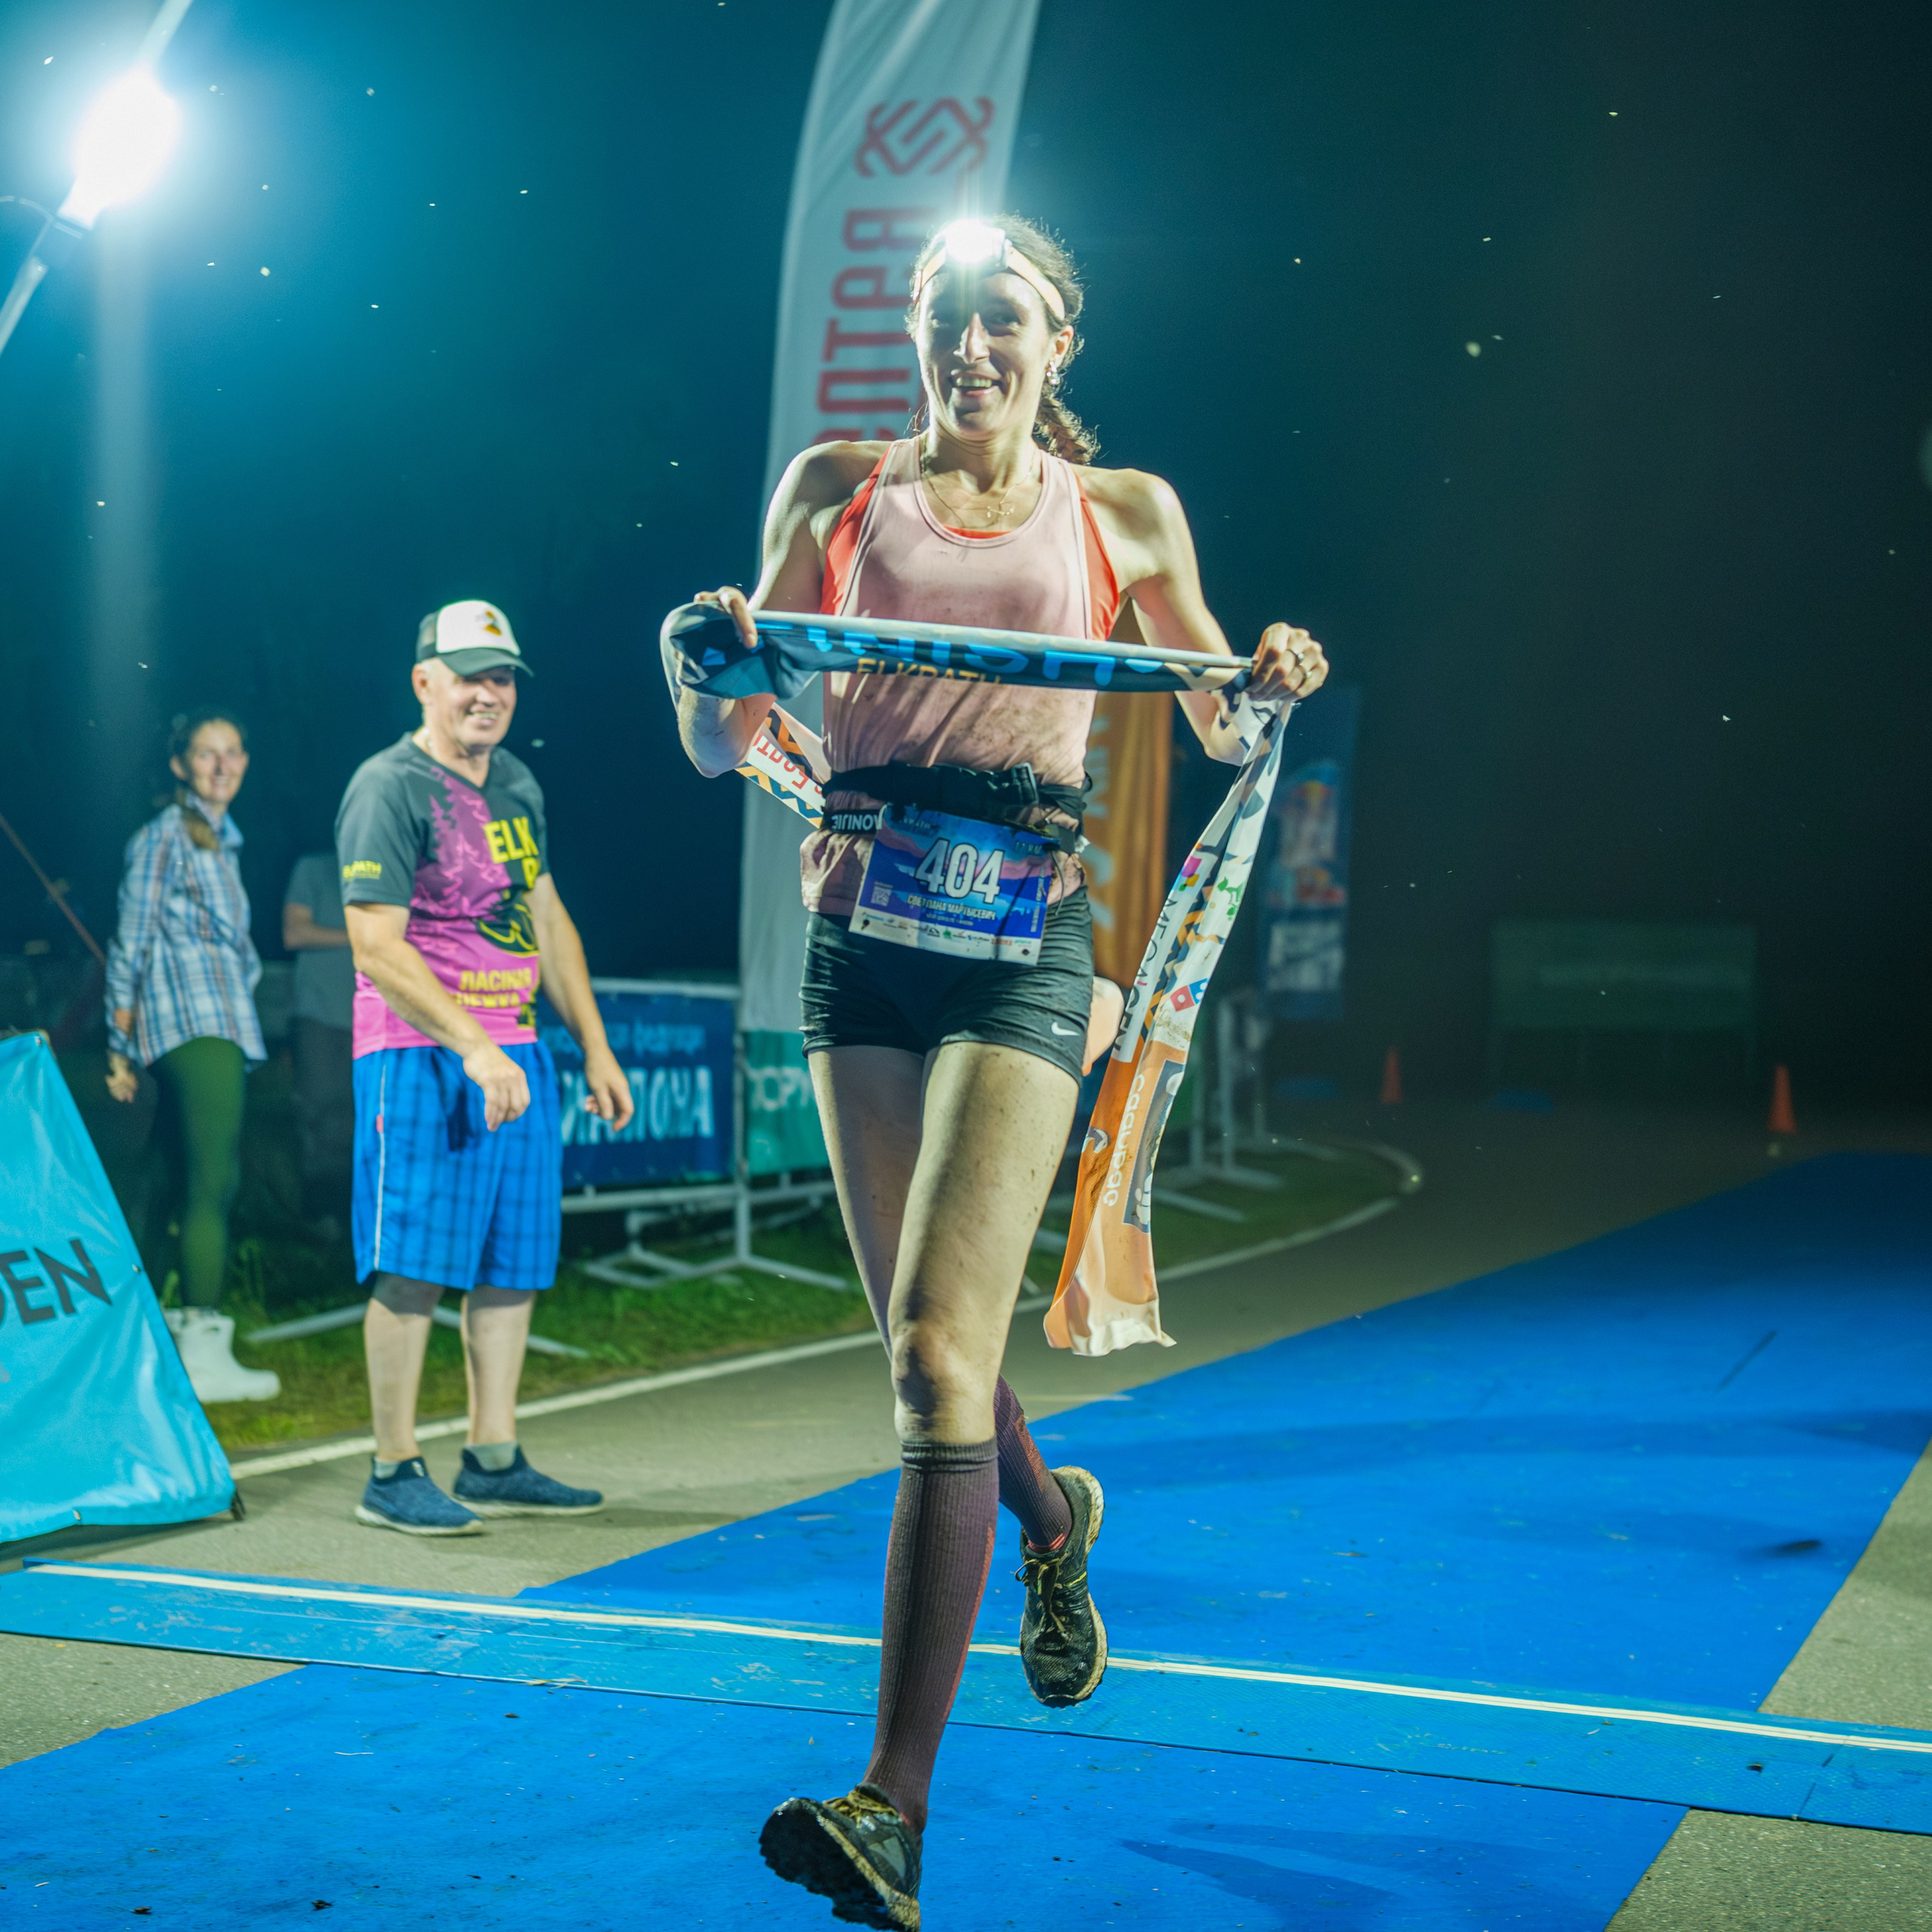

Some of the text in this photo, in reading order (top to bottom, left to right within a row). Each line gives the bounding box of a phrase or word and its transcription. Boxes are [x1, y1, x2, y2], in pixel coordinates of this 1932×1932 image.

[484, 816, 539, 863] ELK
[915, 837, 1004, 904] 404
[0, 1239, 112, 1324] EN
